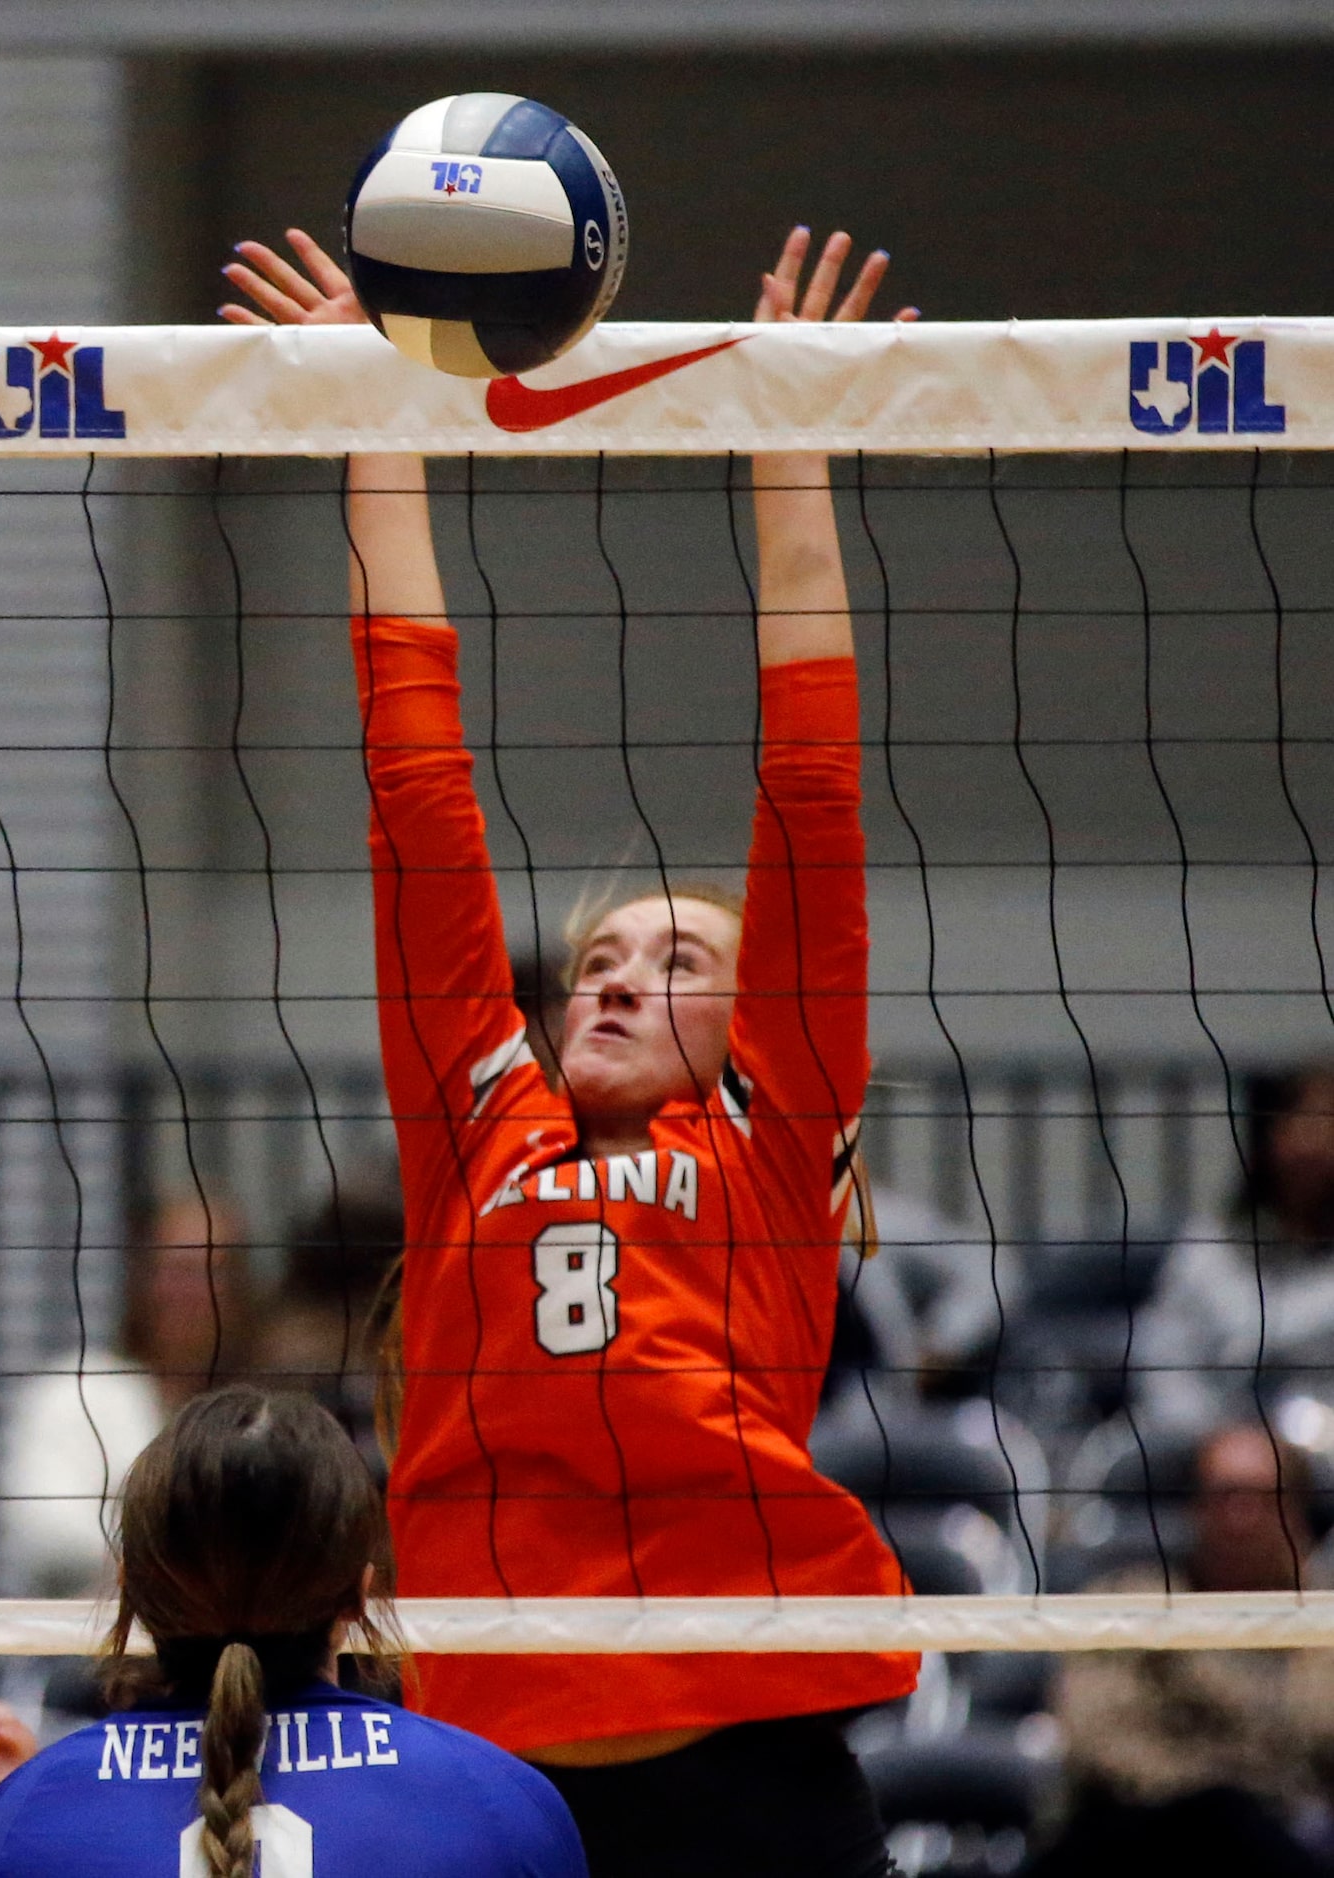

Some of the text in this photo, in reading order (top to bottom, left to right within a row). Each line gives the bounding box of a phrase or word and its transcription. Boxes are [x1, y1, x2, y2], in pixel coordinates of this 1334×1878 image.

[1129, 328, 1286, 435] UIL
[532, 1221, 620, 1359] 8
[97, 1711, 399, 1780] NEEILLE
